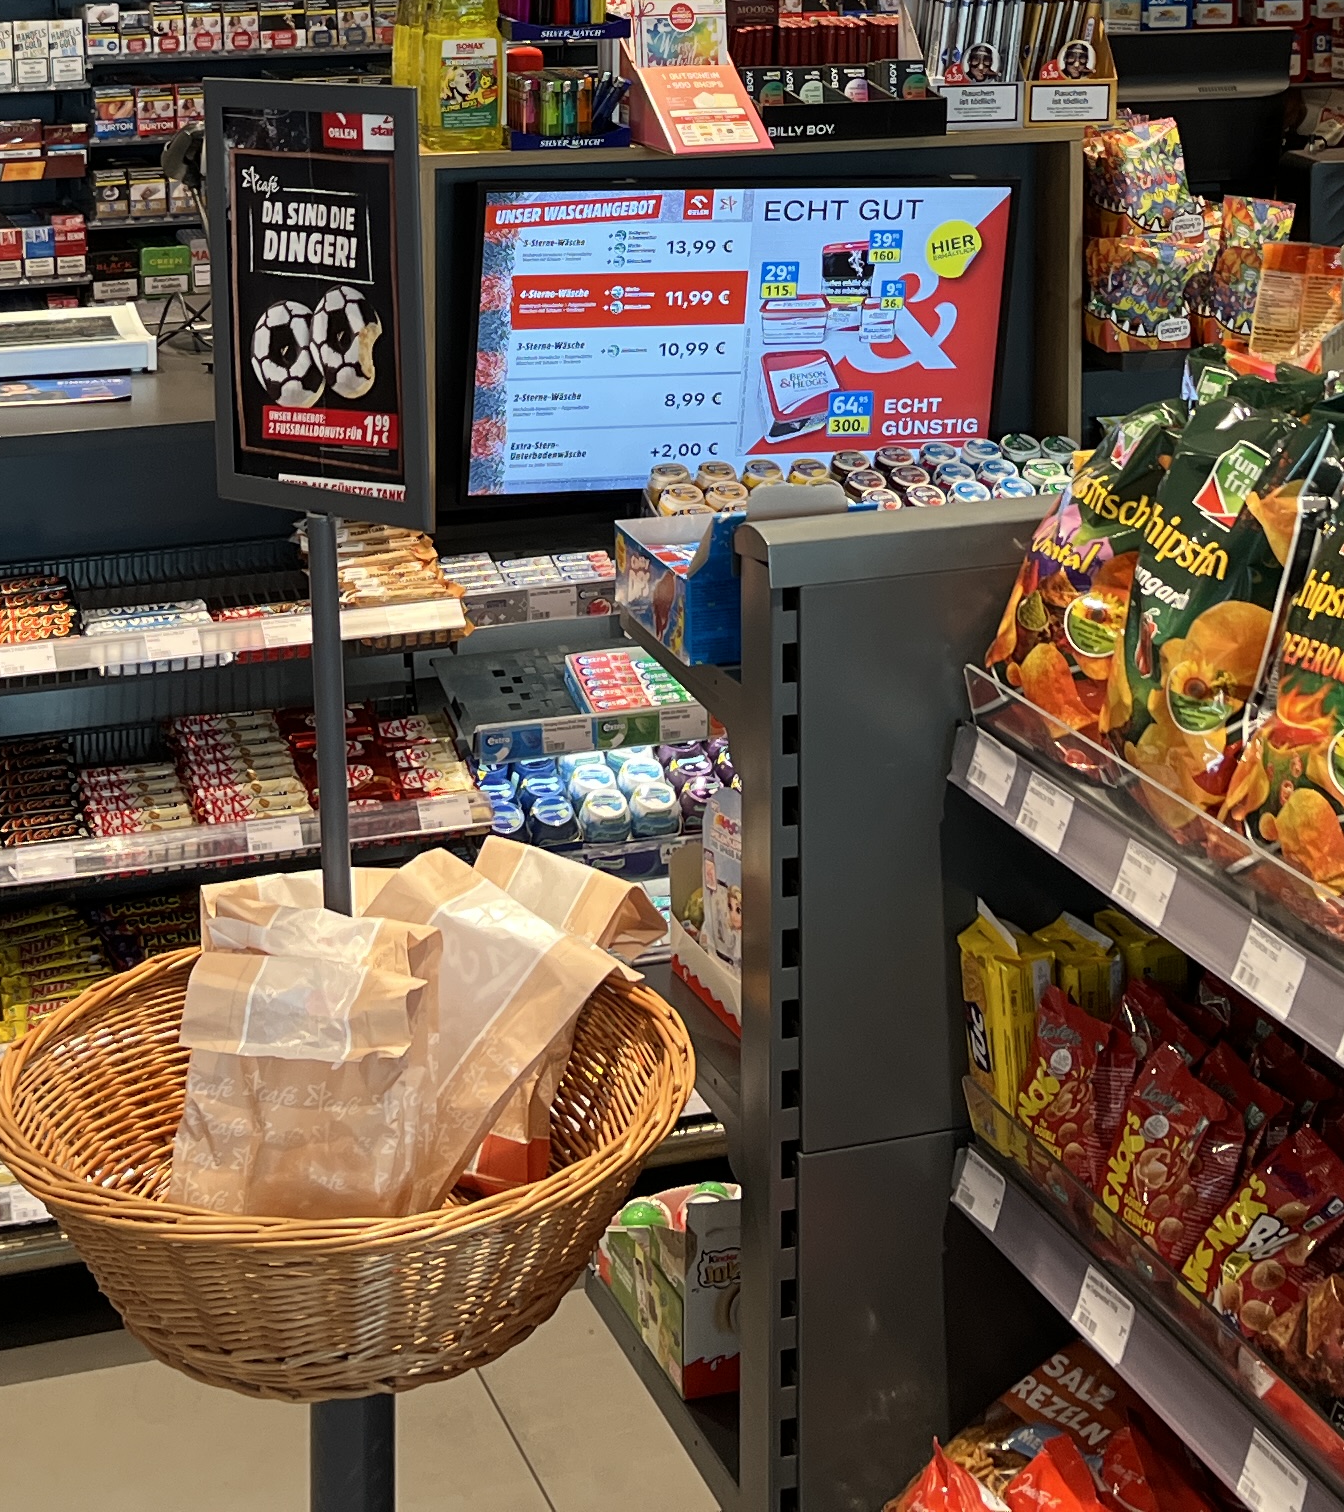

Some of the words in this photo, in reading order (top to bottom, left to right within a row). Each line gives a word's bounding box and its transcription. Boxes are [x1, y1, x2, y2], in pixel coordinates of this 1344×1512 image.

[737, 5, 774, 14] MOODS
[541, 29, 570, 37] SILVER
[328, 127, 357, 141] ORLEN
[767, 126, 803, 138] BILLY
[806, 124, 835, 135] BOY
[255, 178, 280, 197] café
[262, 200, 284, 225] DA
[288, 203, 328, 227] SIND
[330, 205, 355, 230] DIE
[495, 207, 541, 225] UNSER
[544, 200, 656, 221] WASCHANGEBOT
[763, 199, 849, 221] ECHT
[858, 199, 924, 221] GUT
[262, 231, 357, 268] DINGER!
[667, 240, 716, 255] 13,99
[722, 240, 733, 253] €
[931, 234, 975, 253] HIER
[666, 291, 713, 309] 11,99
[718, 291, 730, 305] €
[659, 342, 709, 359] 10,99
[715, 342, 726, 355] €
[790, 371, 826, 381] BENSON
[792, 377, 829, 389] HEDGES
[664, 393, 705, 409] 8,99
[712, 393, 723, 405] €
[884, 398, 942, 414] ECHT
[269, 411, 291, 421] UNSER
[276, 424, 344, 439] FUSSBALLDONUTS
[346, 426, 362, 440] FÜR
[881, 419, 978, 435] GÜNSTIG
[650, 443, 701, 460] +2,00
[708, 443, 719, 455] €
[967, 1011, 990, 1070] TUC
[1042, 1353, 1116, 1412] SALZ
